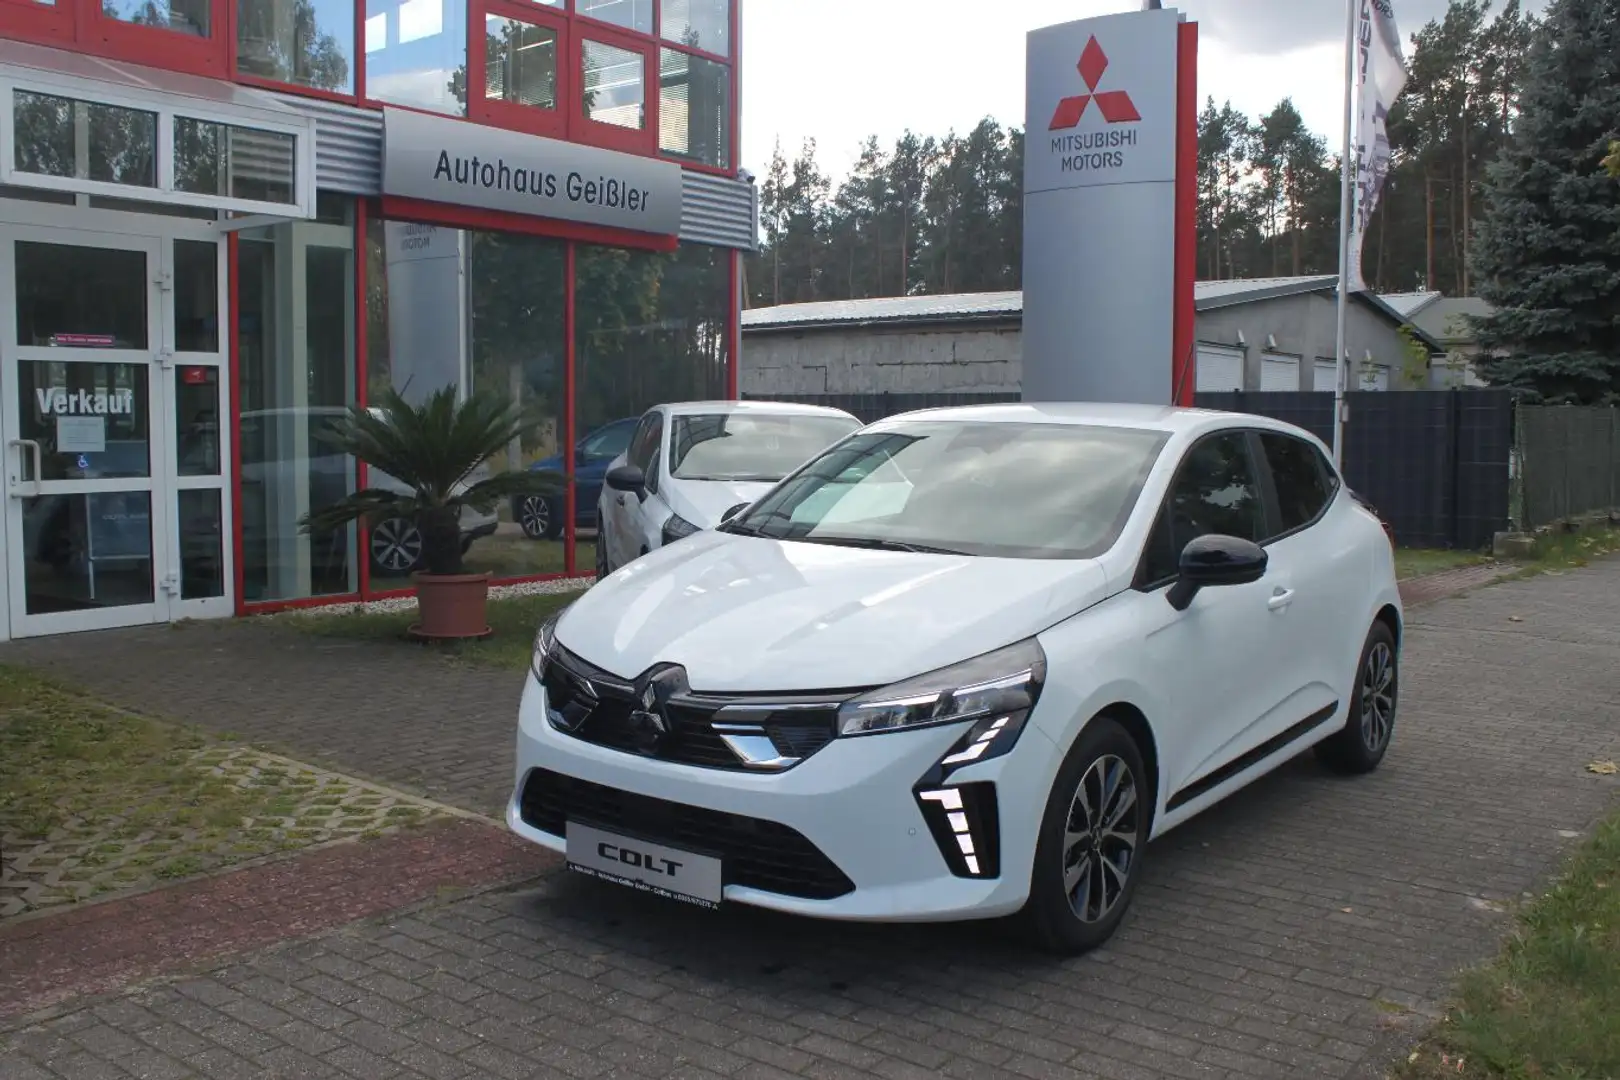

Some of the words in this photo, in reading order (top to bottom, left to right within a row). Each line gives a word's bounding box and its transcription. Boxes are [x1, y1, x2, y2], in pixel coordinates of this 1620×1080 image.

[1051, 129, 1137, 153] MITSUBISHI
[1061, 151, 1124, 172] MOTORS
[433, 149, 557, 198] Autohaus
[566, 171, 649, 212] Geißler
[35, 387, 133, 415] Verkauf
[597, 842, 683, 877] COLT
